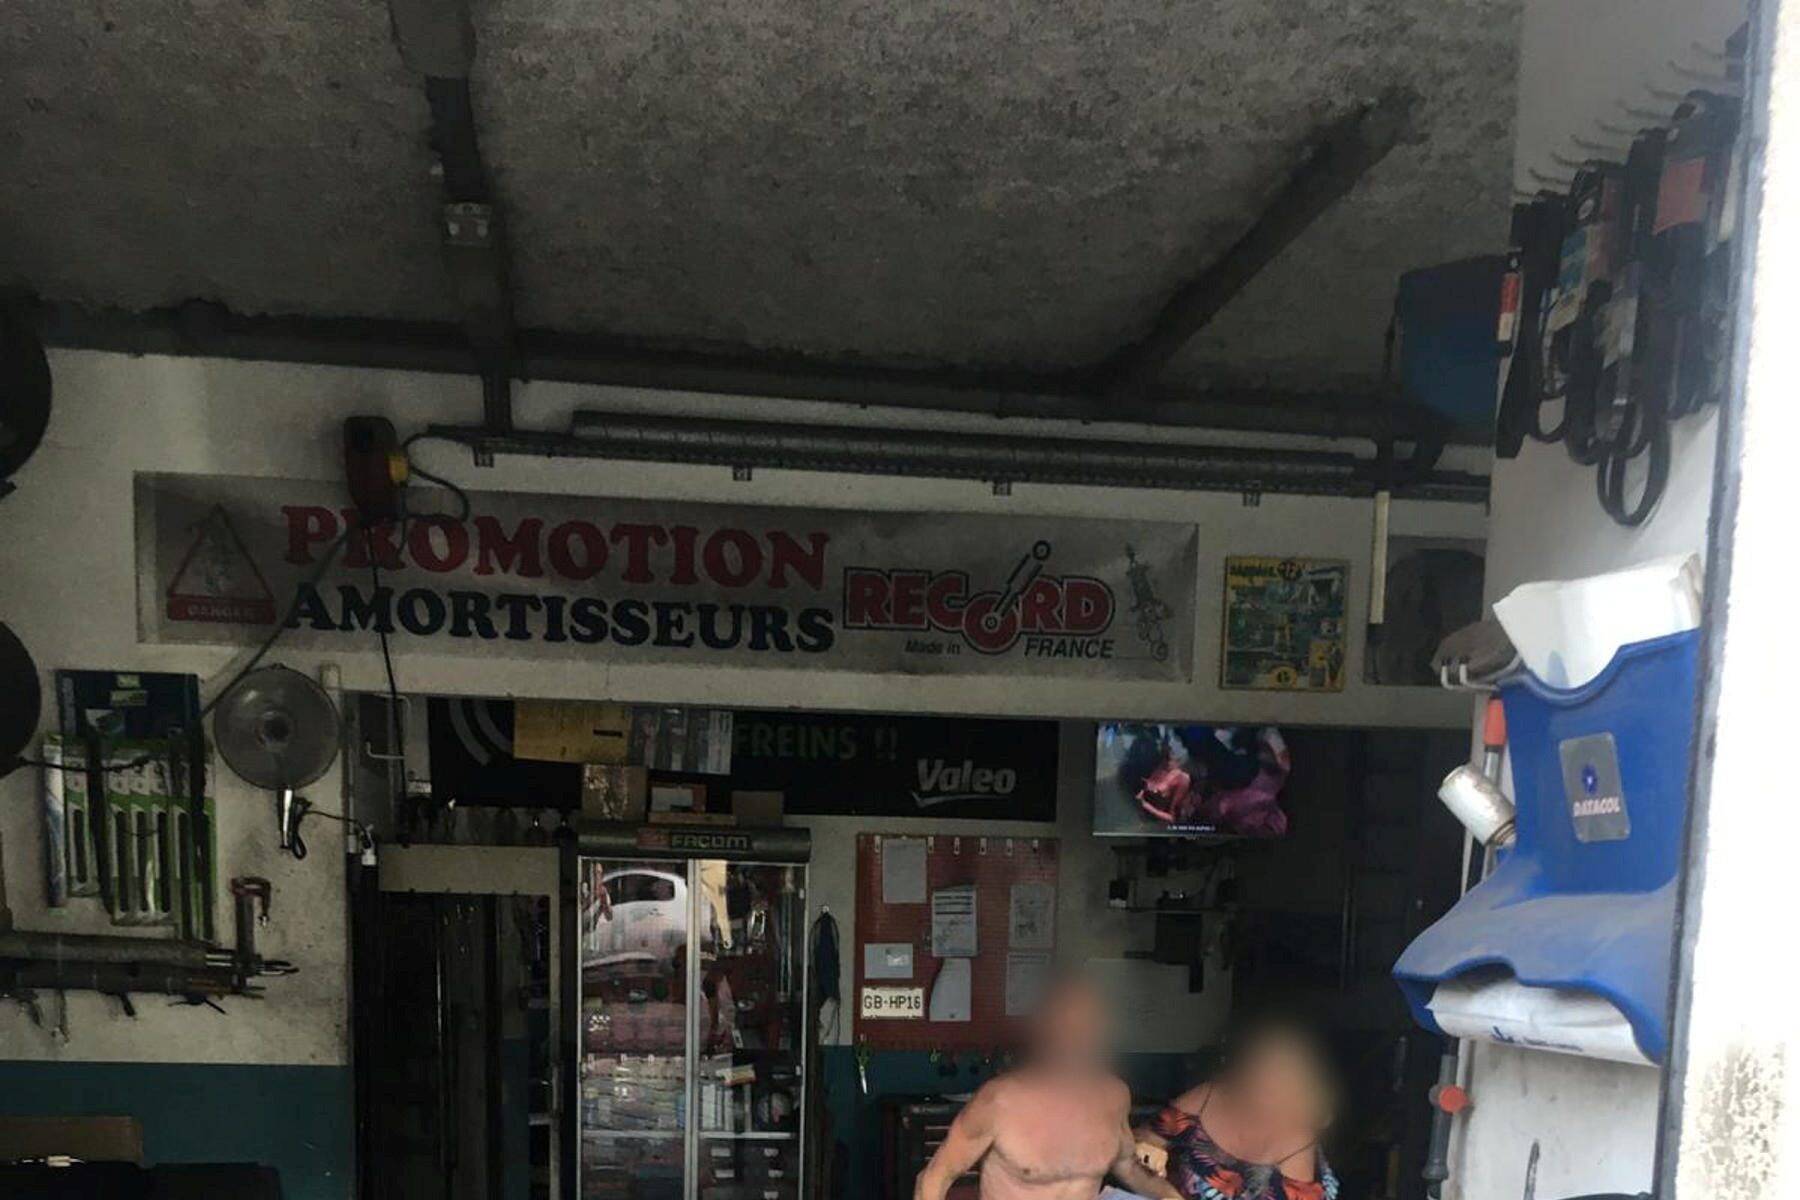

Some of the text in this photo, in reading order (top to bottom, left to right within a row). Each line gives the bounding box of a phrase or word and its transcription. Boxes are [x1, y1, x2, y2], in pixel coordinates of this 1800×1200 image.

[282, 505, 830, 590] PROMOTION
[283, 582, 834, 652] AMORTISSEURS
[844, 566, 1115, 655] RECORD
[1025, 637, 1115, 658] FRANCE
[914, 758, 1017, 795] Valeo
